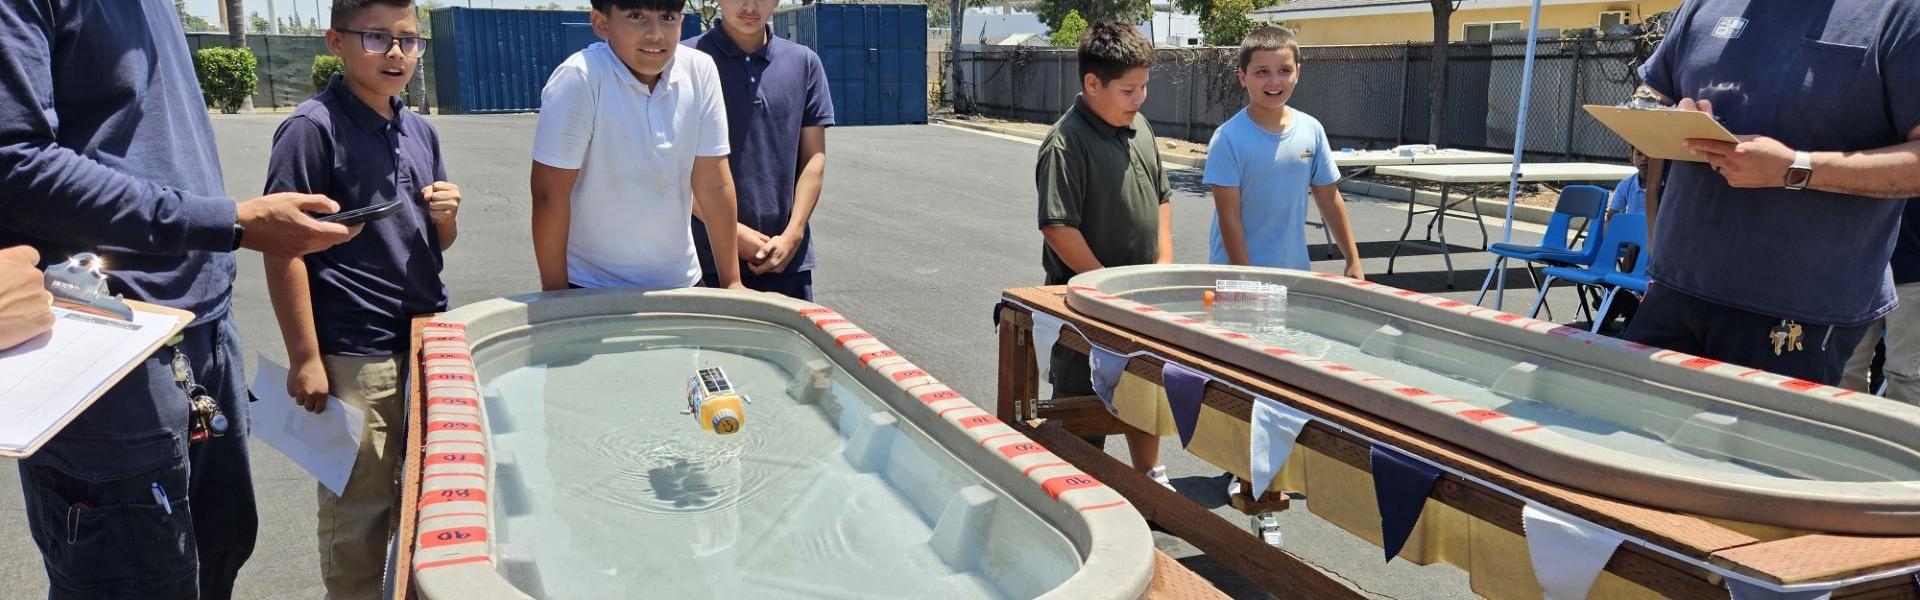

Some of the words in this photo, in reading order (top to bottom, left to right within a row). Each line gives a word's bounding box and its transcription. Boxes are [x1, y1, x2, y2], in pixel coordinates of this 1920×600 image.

[1065, 476, 1092, 486] 90
[441, 488, 470, 498] 80
[437, 531, 471, 541] 90
